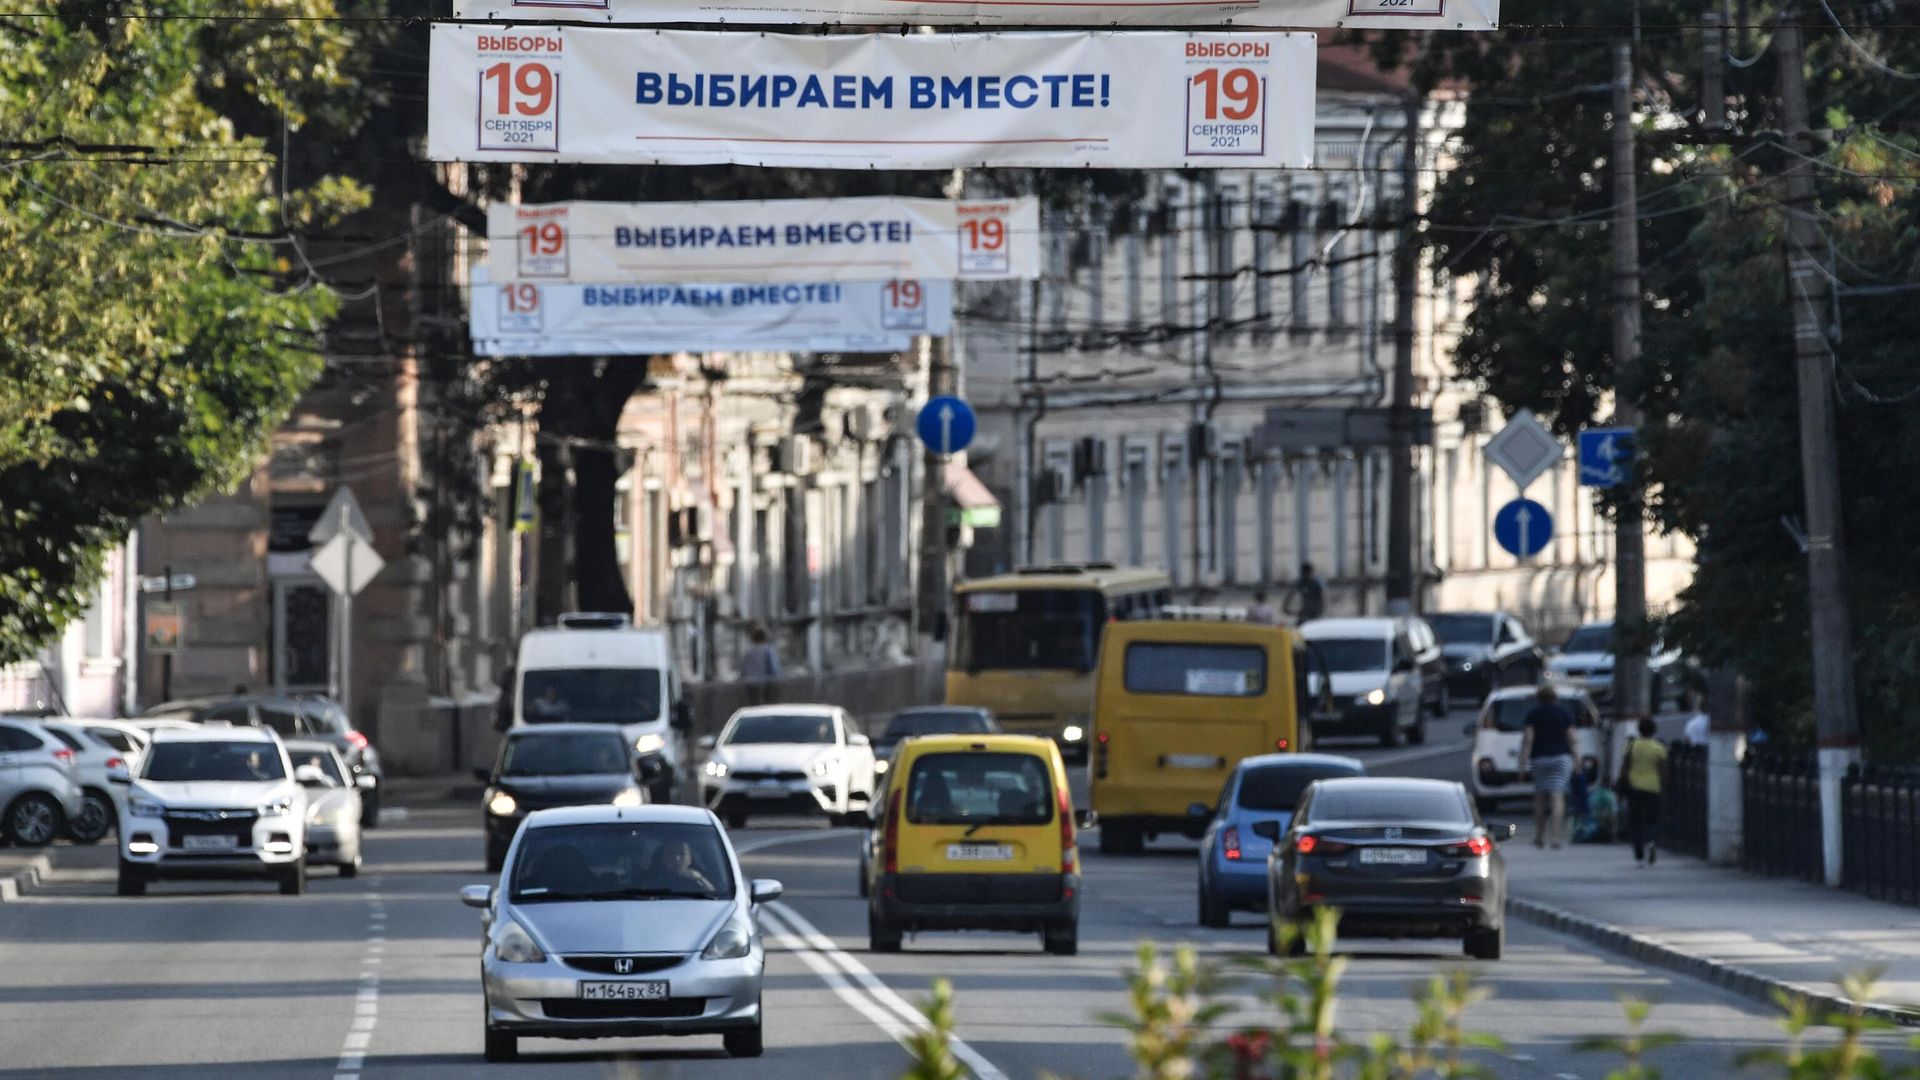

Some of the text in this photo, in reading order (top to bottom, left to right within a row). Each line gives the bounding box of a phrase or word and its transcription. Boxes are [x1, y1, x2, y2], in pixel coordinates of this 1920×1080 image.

[477, 36, 563, 52] ВЫБОРЫ
[1185, 42, 1270, 57] ВЫБОРЫ
[485, 62, 553, 116] 19
[635, 72, 1111, 109] ВЫБИРАЕМ ВМЕСТЕ!
[1193, 67, 1260, 121] 19
[484, 119, 553, 132] СЕНТЯБРЯ
[503, 132, 534, 143] 2021
[1192, 124, 1259, 136] СЕНТЯБРЯ
[1211, 136, 1240, 147] 2021
[522, 222, 563, 256] 19
[615, 220, 912, 248] ВЫБИРАЕМ ВМЕСТЕ!
[962, 218, 1004, 250] 19
[502, 283, 540, 313] 19
[583, 283, 841, 308] ВЫБИРАЕМ ВМЕСТЕ!
[885, 280, 923, 309] 19
